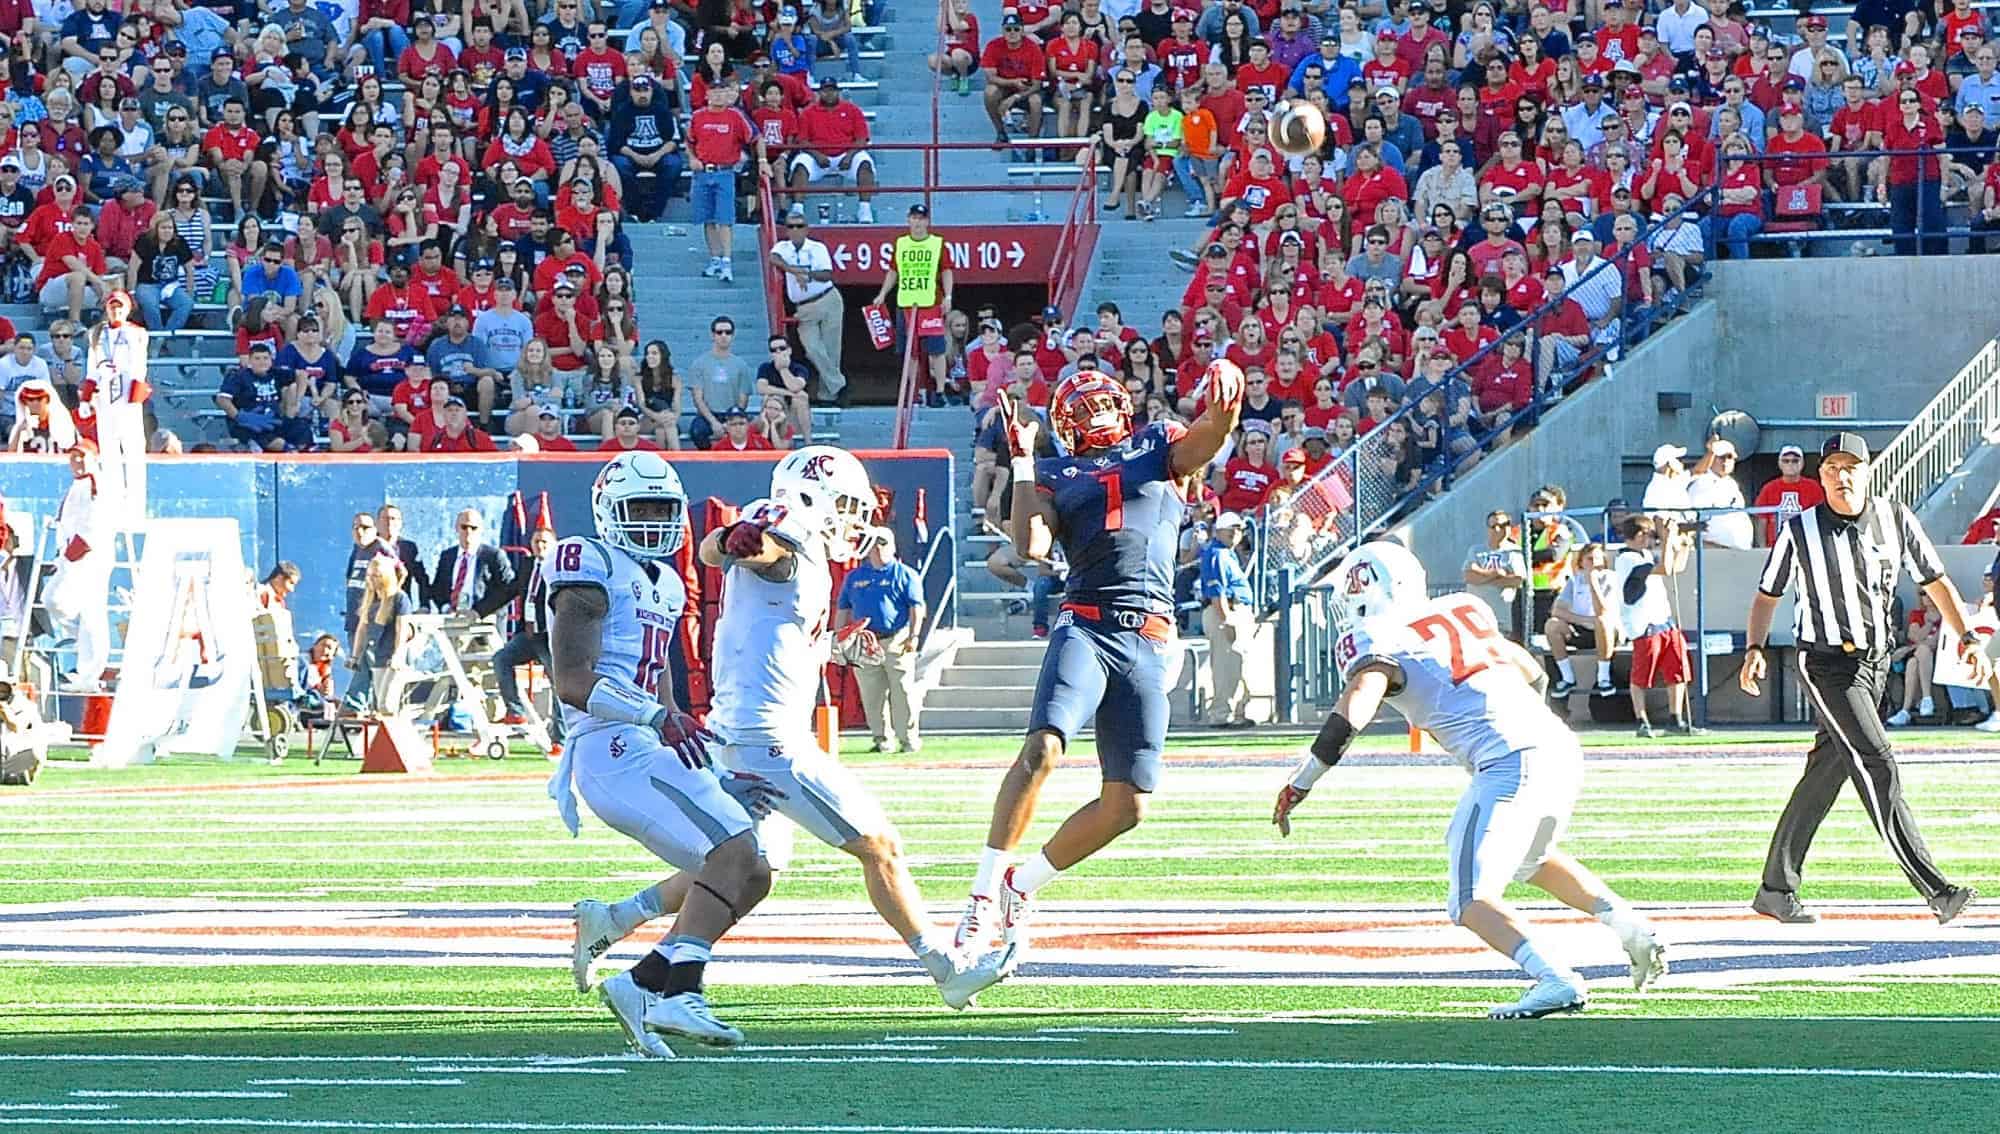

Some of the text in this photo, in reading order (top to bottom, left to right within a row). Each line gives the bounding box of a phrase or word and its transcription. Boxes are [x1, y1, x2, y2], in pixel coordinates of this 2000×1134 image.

[763, 119, 784, 145] A
[856, 242, 872, 270] 9
[902, 250, 932, 262] FOOD
[977, 241, 1001, 270] 10
[901, 277, 930, 290] SEAT
[869, 309, 891, 343] FOOD
[1822, 396, 1848, 417] EXIT
[1097, 471, 1125, 532] 1
[555, 543, 583, 572] 18
[1408, 604, 1508, 687] 29
